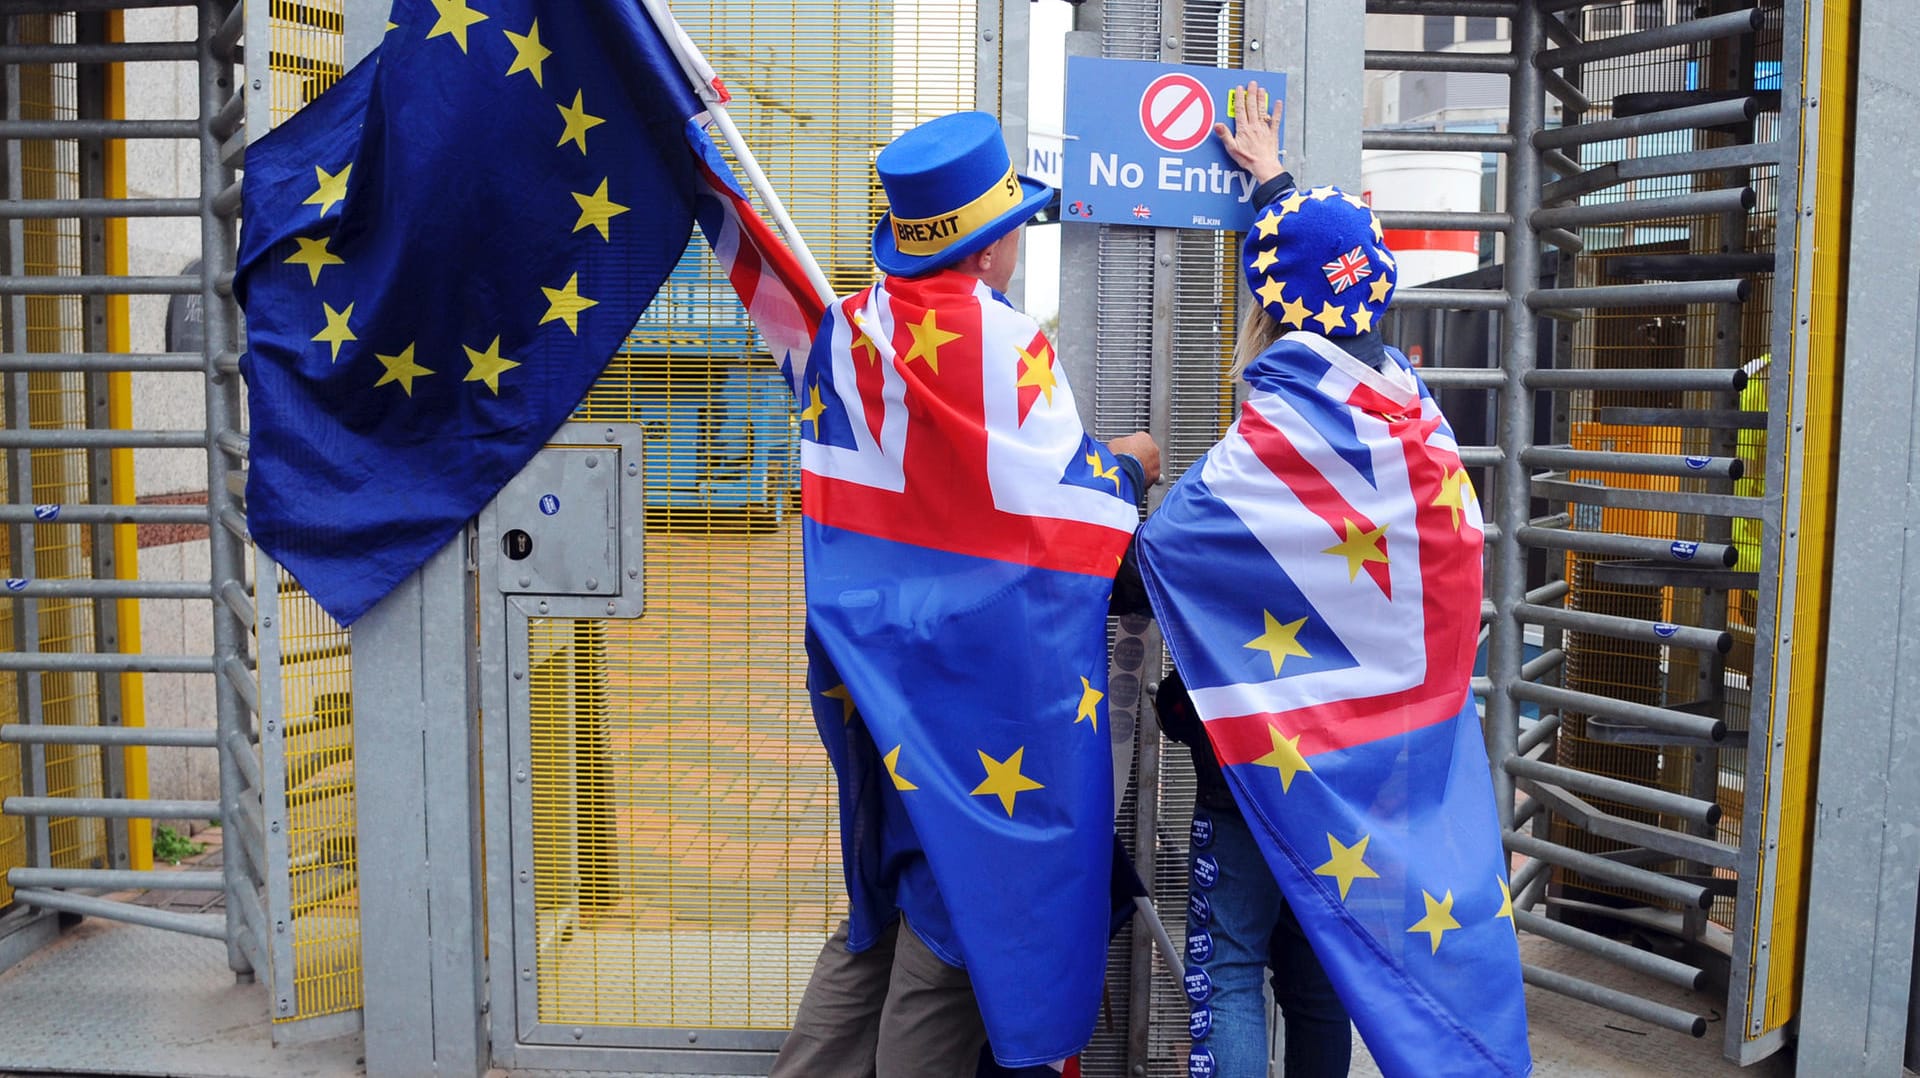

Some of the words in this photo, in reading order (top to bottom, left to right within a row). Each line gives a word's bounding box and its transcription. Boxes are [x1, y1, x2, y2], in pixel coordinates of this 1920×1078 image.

[1089, 152, 1144, 188] No
[1158, 157, 1256, 203] Entry
[896, 215, 960, 242] BREXIT
